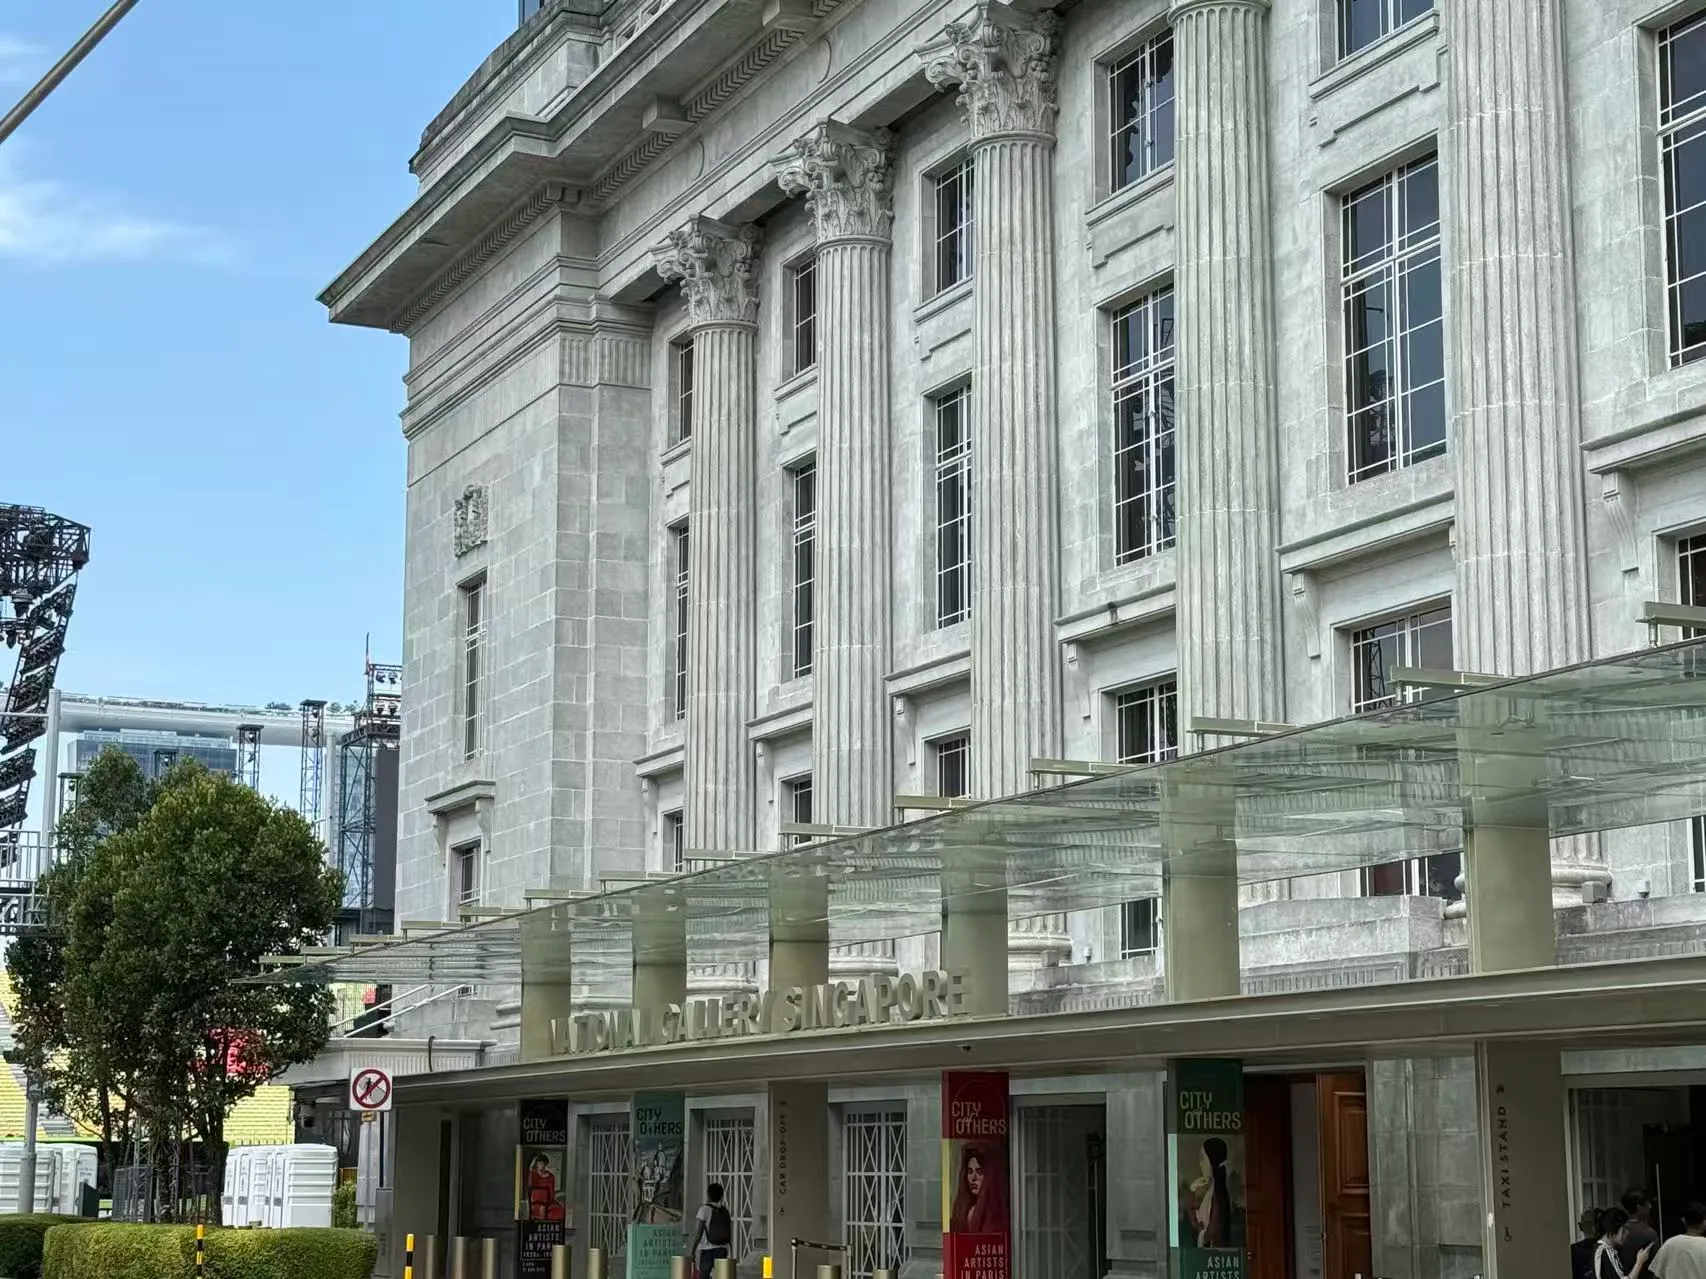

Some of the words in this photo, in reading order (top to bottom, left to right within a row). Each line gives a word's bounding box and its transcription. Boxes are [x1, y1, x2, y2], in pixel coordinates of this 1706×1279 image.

[784, 969, 967, 1032] SINGAPORE
[1180, 1091, 1213, 1109] CITY
[637, 1108, 662, 1121] CITY
[951, 1101, 982, 1117] CITY
[523, 1117, 547, 1130] CITY
[956, 1118, 1007, 1135] OTHERS
[1184, 1111, 1241, 1130] OTHERS
[640, 1121, 683, 1135] OTHERS
[1497, 1105, 1509, 1163] STAND
[525, 1130, 567, 1143] OTHERS
[1500, 1168, 1512, 1209] TAXI
[537, 1223, 560, 1233] ASIAN
[528, 1232, 560, 1242] ARTISTS
[536, 1241, 555, 1250] PAR
[975, 1243, 1004, 1256] ASIAN
[964, 1256, 1004, 1269] ARTISTS
[1207, 1255, 1239, 1269] ASIAN
[975, 1269, 1004, 1279] PARIS
[1196, 1270, 1240, 1279] ARTISTS
